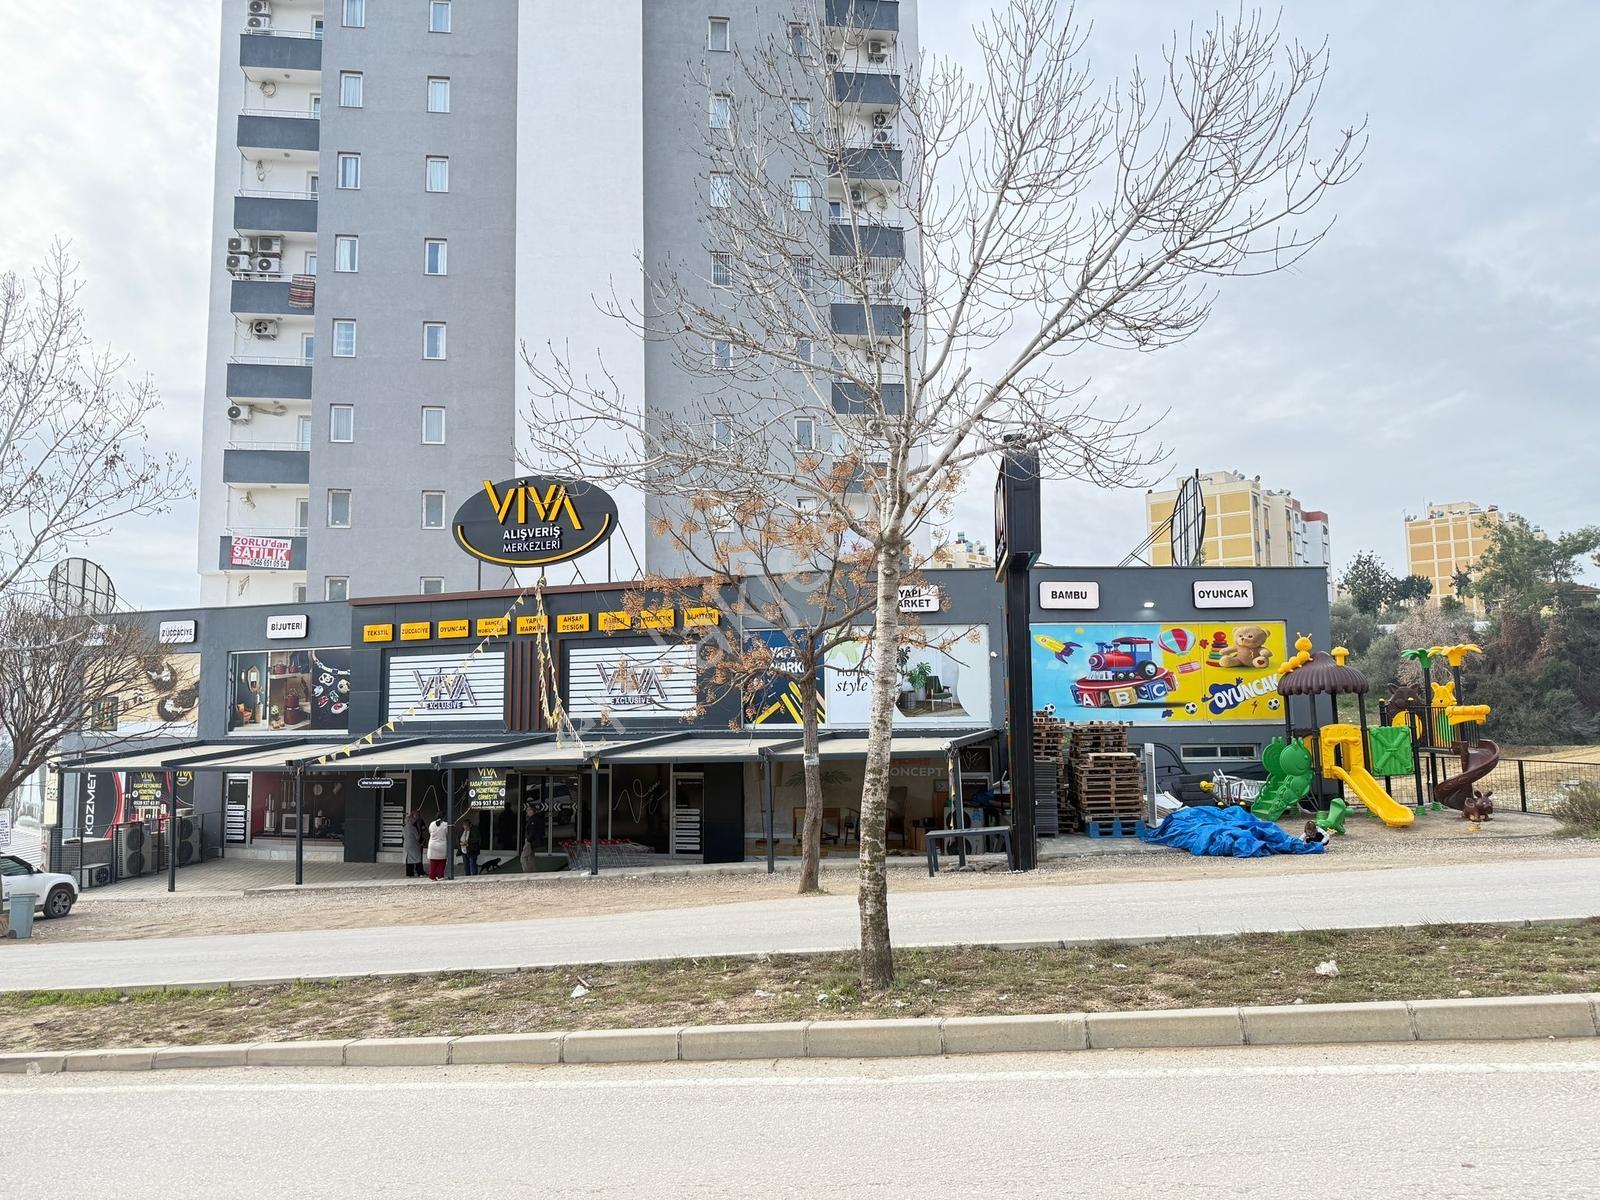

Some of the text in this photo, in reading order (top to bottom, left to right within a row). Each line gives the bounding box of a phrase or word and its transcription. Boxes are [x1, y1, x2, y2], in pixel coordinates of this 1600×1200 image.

[502, 523, 561, 540] ALIŞVERİŞ
[234, 536, 289, 549] ZORLU'dan
[502, 538, 560, 553] MERKEZLERİ
[233, 546, 288, 561] SATILIK
[898, 589, 921, 598] YAPI
[1051, 590, 1088, 600] BAMBU
[1198, 589, 1248, 599] OYUNCAK
[897, 599, 931, 608] ARKET
[563, 615, 583, 624] AHŞAP
[270, 622, 303, 631] BİJUTERİ
[440, 625, 467, 633] OYUNCAK
[836, 677, 868, 696] style
[1214, 674, 1278, 709] OYUNCAK
[889, 767, 944, 777] ONCEPT
